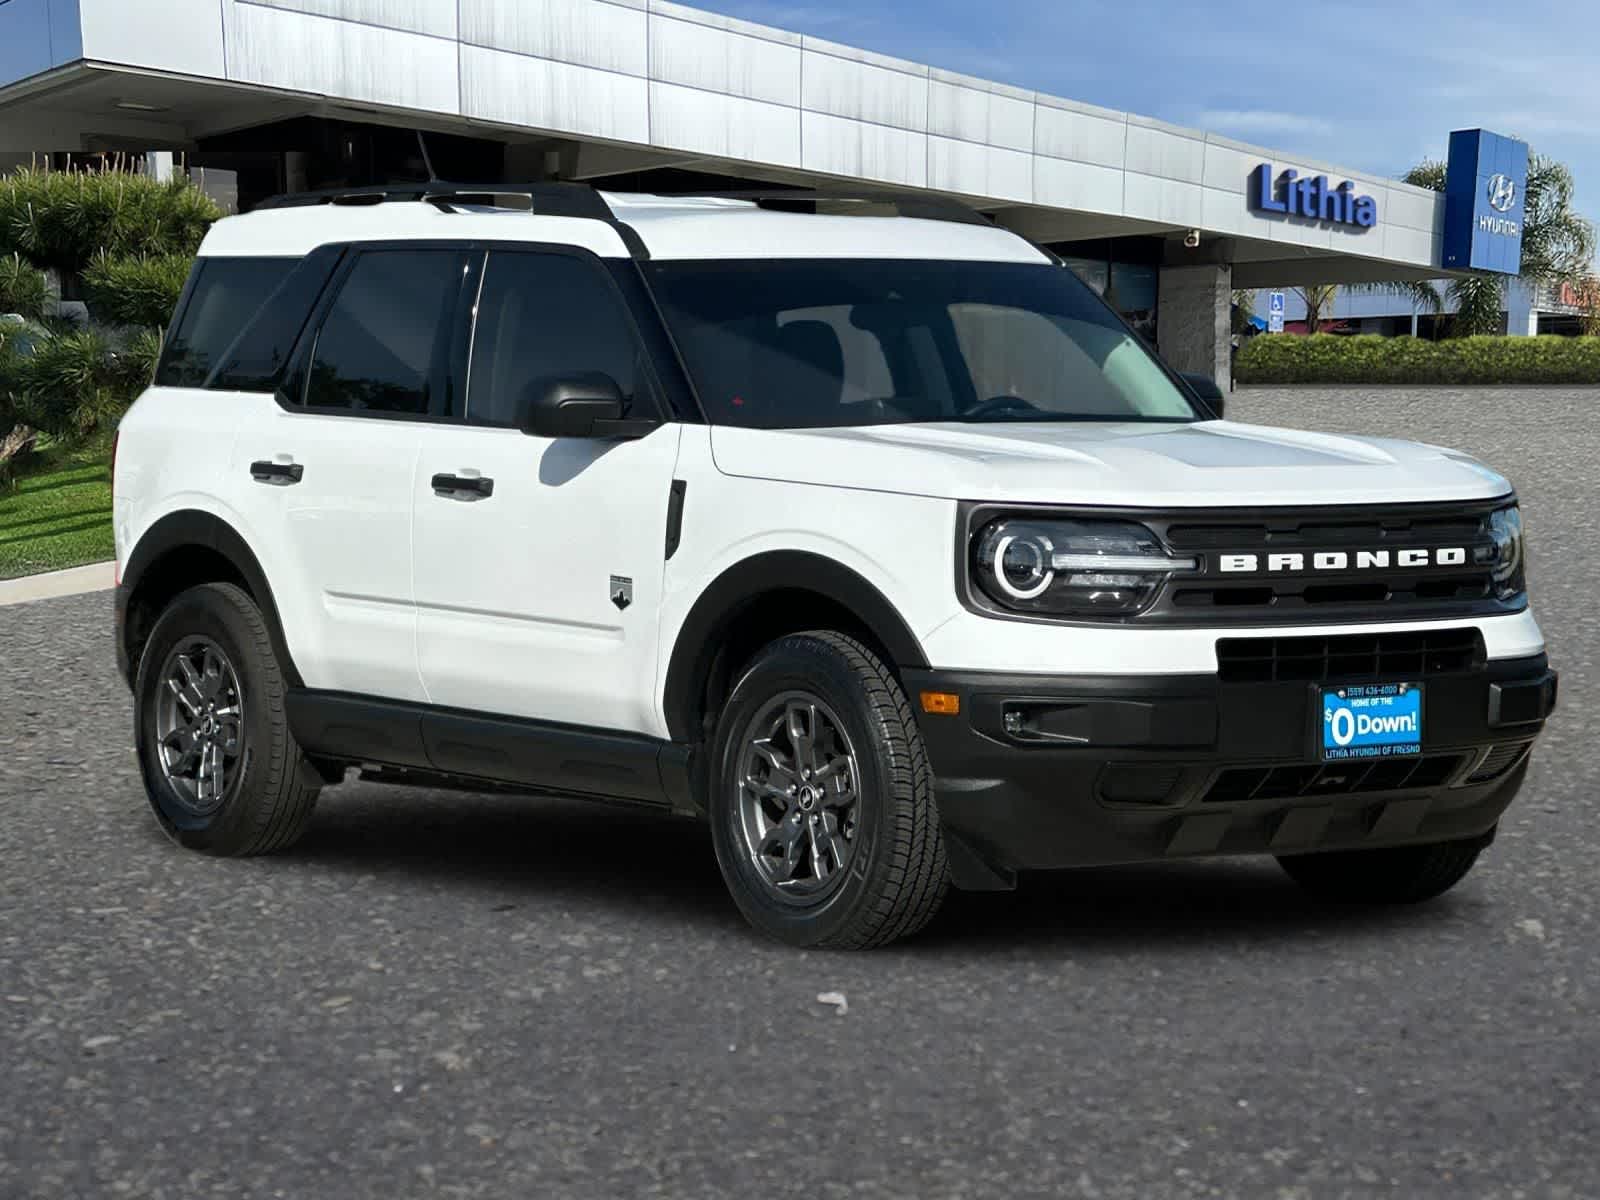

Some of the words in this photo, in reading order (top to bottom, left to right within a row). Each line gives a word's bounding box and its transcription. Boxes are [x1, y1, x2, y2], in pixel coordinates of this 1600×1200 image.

[1259, 164, 1376, 227] Lithia
[1479, 215, 1520, 238] HYUNDAI
[1220, 548, 1465, 572] BRONCO
[1351, 698, 1369, 707] HOME
[1370, 698, 1379, 706] OF
[1380, 697, 1393, 705] THE
[1357, 711, 1416, 735] Down!
[1325, 748, 1348, 759] LITHIA
[1349, 746, 1380, 758] HYUNDAI
[1382, 746, 1391, 755] OF
[1393, 744, 1420, 754] FRESNO
